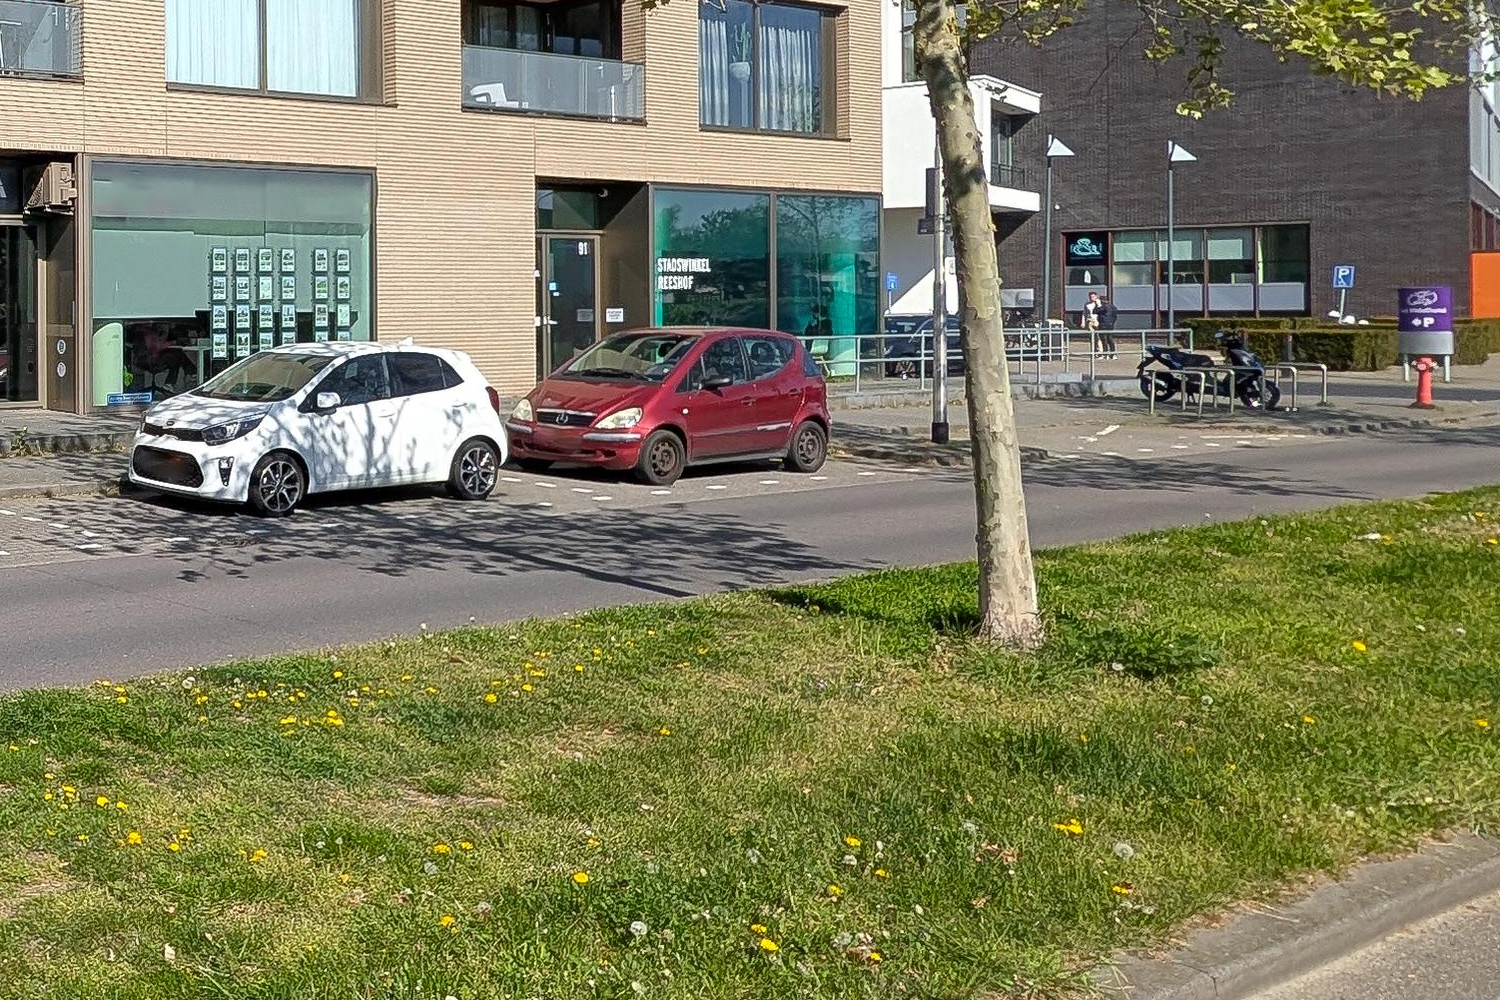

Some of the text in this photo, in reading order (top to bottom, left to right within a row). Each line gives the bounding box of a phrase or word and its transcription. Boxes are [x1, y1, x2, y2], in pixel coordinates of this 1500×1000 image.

[657, 257, 711, 273] STADSWINKEL
[657, 275, 694, 290] REESHOF
[1423, 317, 1435, 328] P
